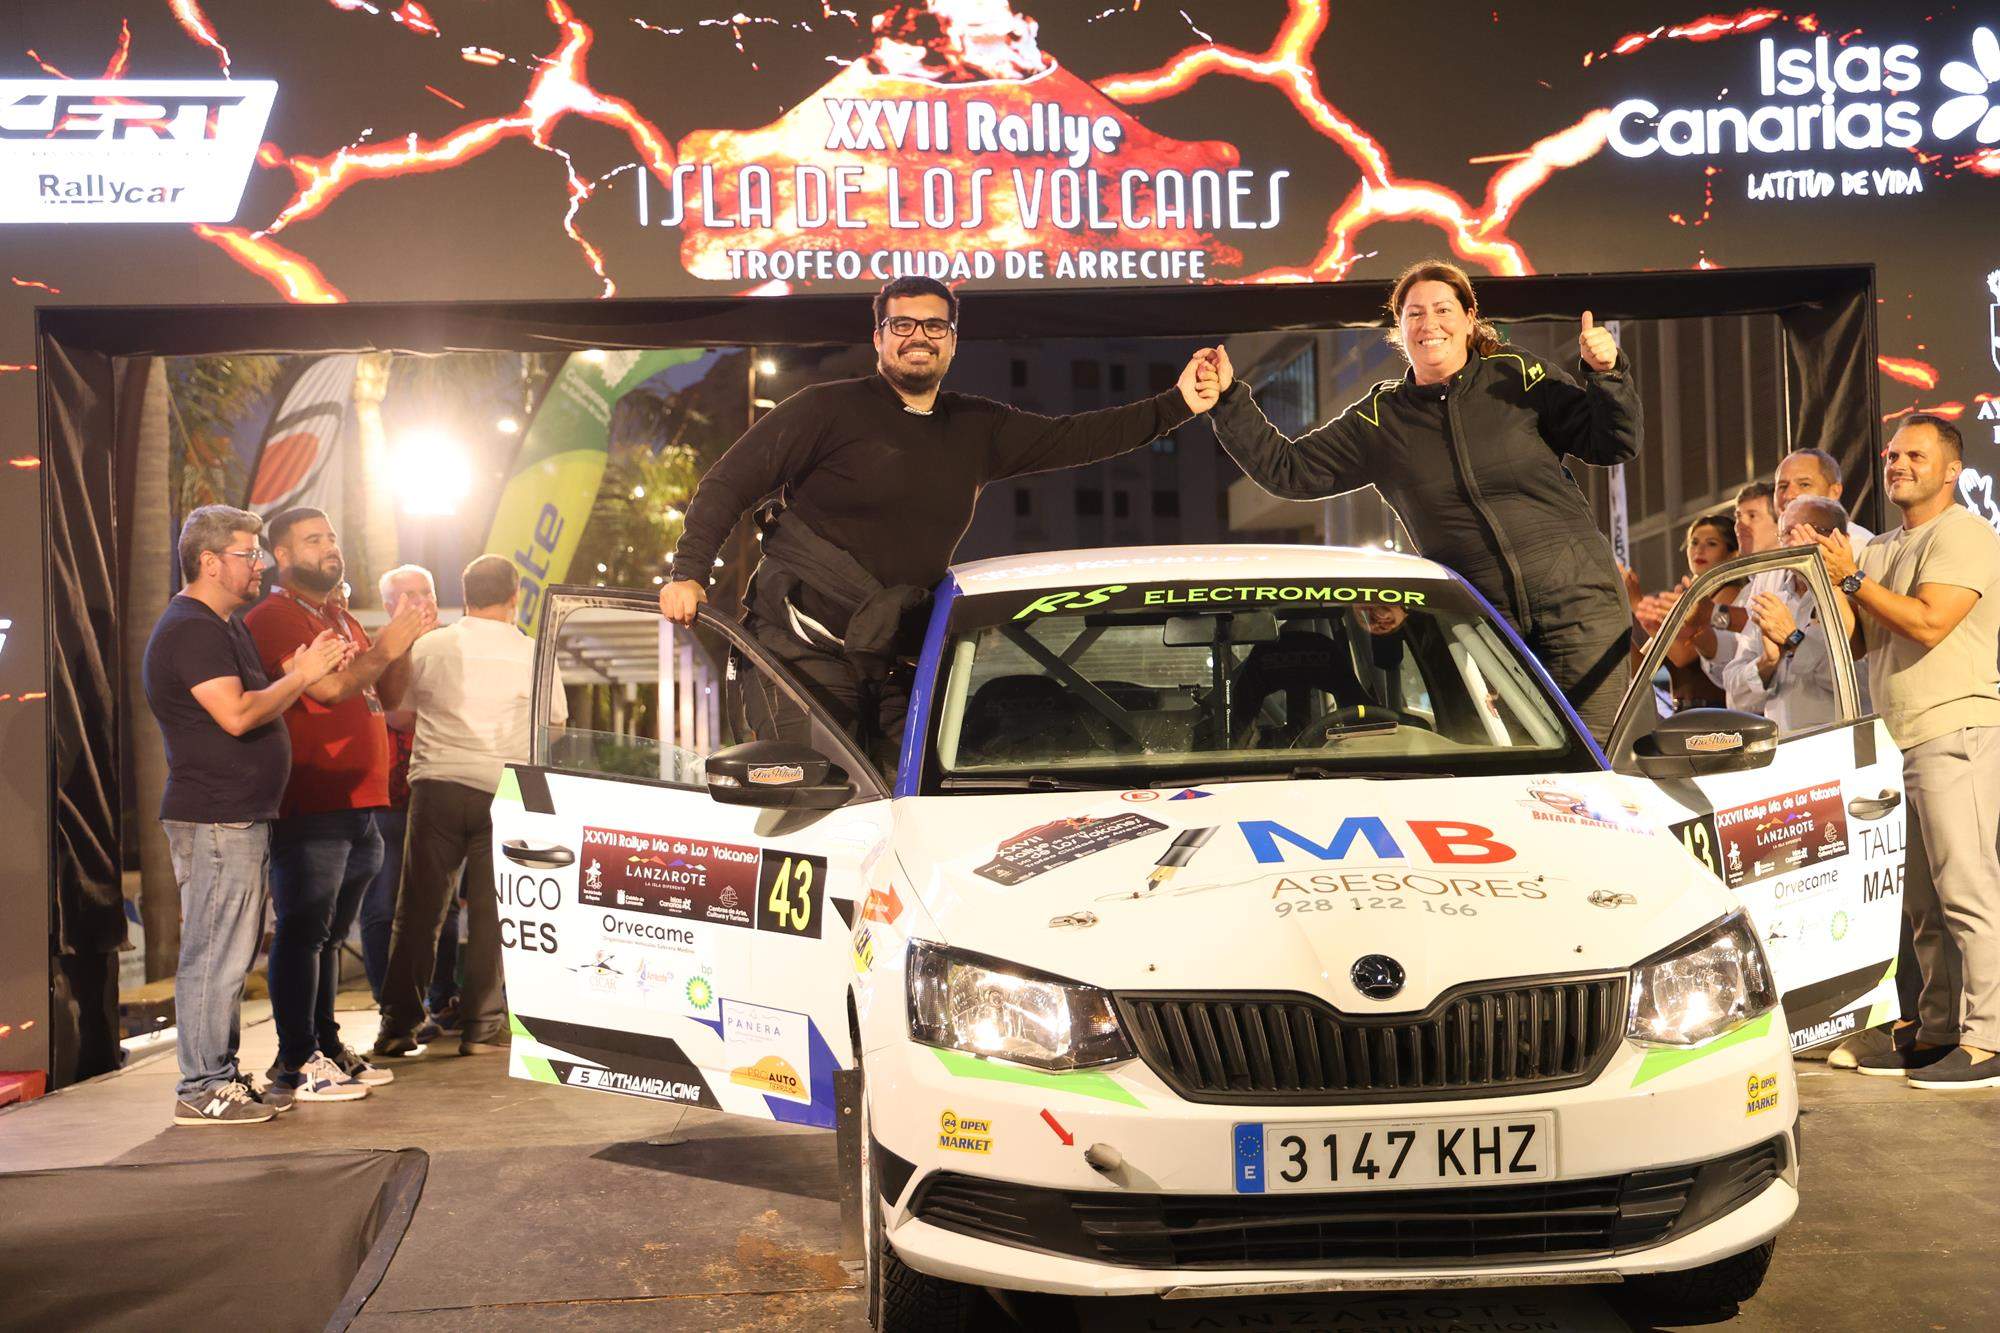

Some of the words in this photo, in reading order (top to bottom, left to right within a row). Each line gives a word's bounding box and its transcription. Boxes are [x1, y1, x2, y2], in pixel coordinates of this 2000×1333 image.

[1760, 36, 1922, 97] Islas
[823, 99, 949, 153] XXVII
[967, 100, 1123, 168] Rallye
[1605, 92, 1925, 159] Canarias
[38, 174, 185, 204] Rallycar
[637, 164, 772, 230] ISLA
[796, 165, 868, 230] DE
[889, 166, 993, 230] LOS
[1013, 167, 1291, 230] VOLCANES
[1748, 167, 1836, 201] LATITUD
[1841, 168, 1869, 197] DE
[1874, 167, 1924, 196] VIDA
[728, 249, 861, 281] TROFEO
[871, 248, 994, 280] CIUDAD
[1005, 250, 1044, 279] DE
[1056, 250, 1206, 280] ARRECIFE
[1011, 585, 1128, 620] RS
[1144, 586, 1427, 607] ELECTROMOTOR
[1716, 813, 1743, 829] XXVII
[1757, 820, 1815, 847] LANZAROTE
[584, 829, 617, 847] XXVII
[619, 833, 650, 852] Rallye
[674, 840, 688, 855] de
[691, 843, 708, 857] Los
[712, 846, 759, 864] Volcanes
[997, 835, 1044, 857] XXVII
[1051, 838, 1077, 852] Los
[1237, 816, 1517, 864] MB
[1859, 821, 1906, 861] TALL
[626, 865, 706, 887] LANZAROTE
[1272, 873, 1548, 899] ASESORES
[1775, 868, 1839, 899] Orvecame
[768, 857, 813, 931] 43
[1275, 898, 1333, 918] 928
[1351, 896, 1407, 909] 122
[1422, 900, 1478, 917] 166
[499, 918, 558, 954] CES
[602, 914, 695, 945] Orvecame
[727, 1016, 781, 1037] PANERA
[1747, 1093, 1778, 1113] MARKET
[944, 1119, 957, 1128] 24
[960, 1120, 989, 1132] OPEN
[940, 1135, 991, 1152] MARKET
[1280, 1131, 1417, 1183] 3147
[1437, 1124, 1538, 1177] KHZ
[1244, 1165, 1257, 1180] E
